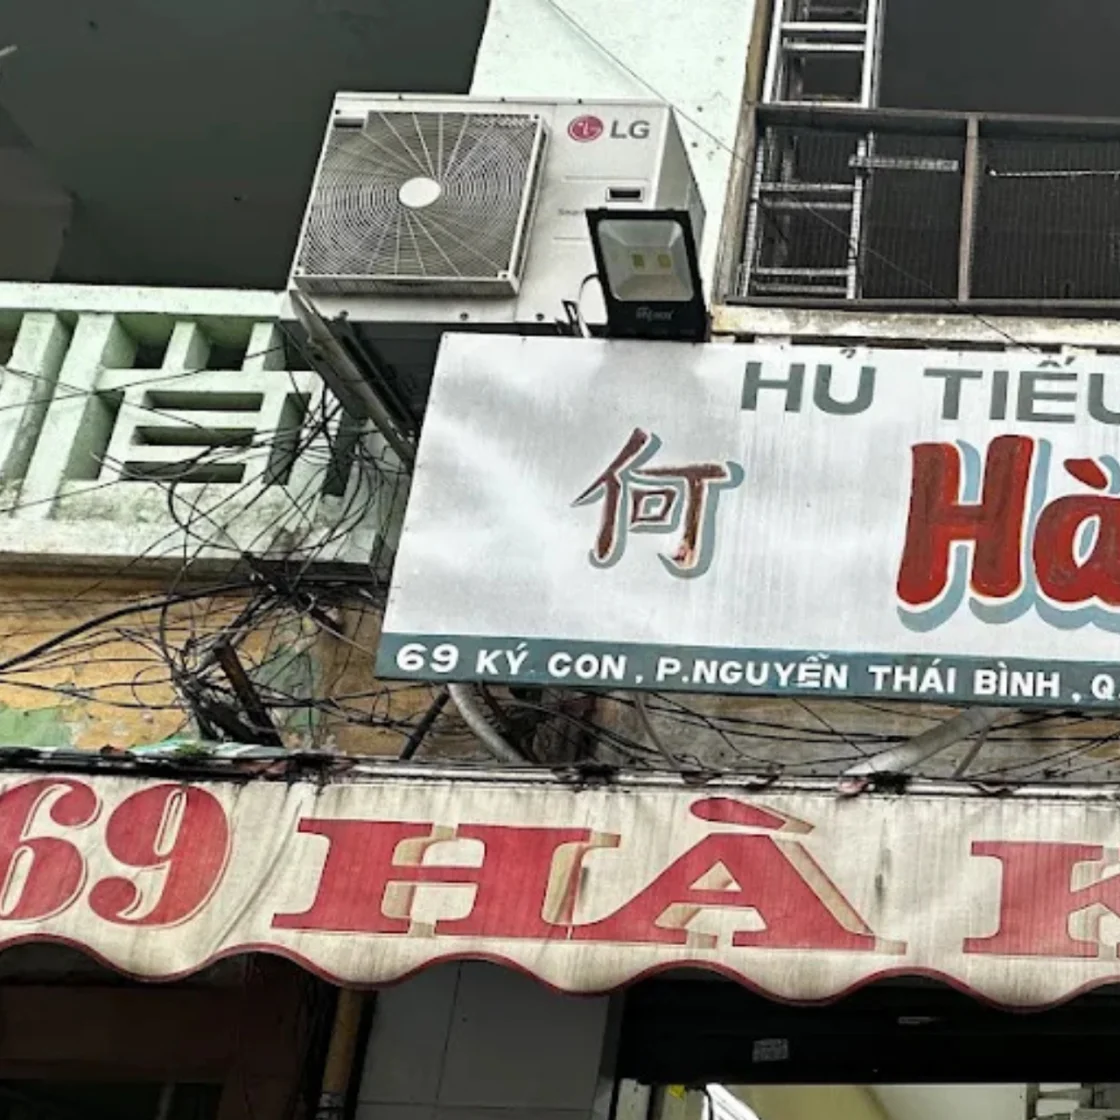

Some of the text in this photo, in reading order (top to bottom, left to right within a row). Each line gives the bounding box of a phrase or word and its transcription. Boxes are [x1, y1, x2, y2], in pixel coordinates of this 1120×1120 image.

[610, 119, 650, 139] LG
[741, 349, 876, 415] HỦ
[570, 427, 745, 579] 何
[396, 643, 460, 673] 69
[474, 642, 529, 676] KÝ
[867, 658, 957, 695] THÁI
[0, 776, 233, 928] 69
[271, 797, 907, 955] HÀ
